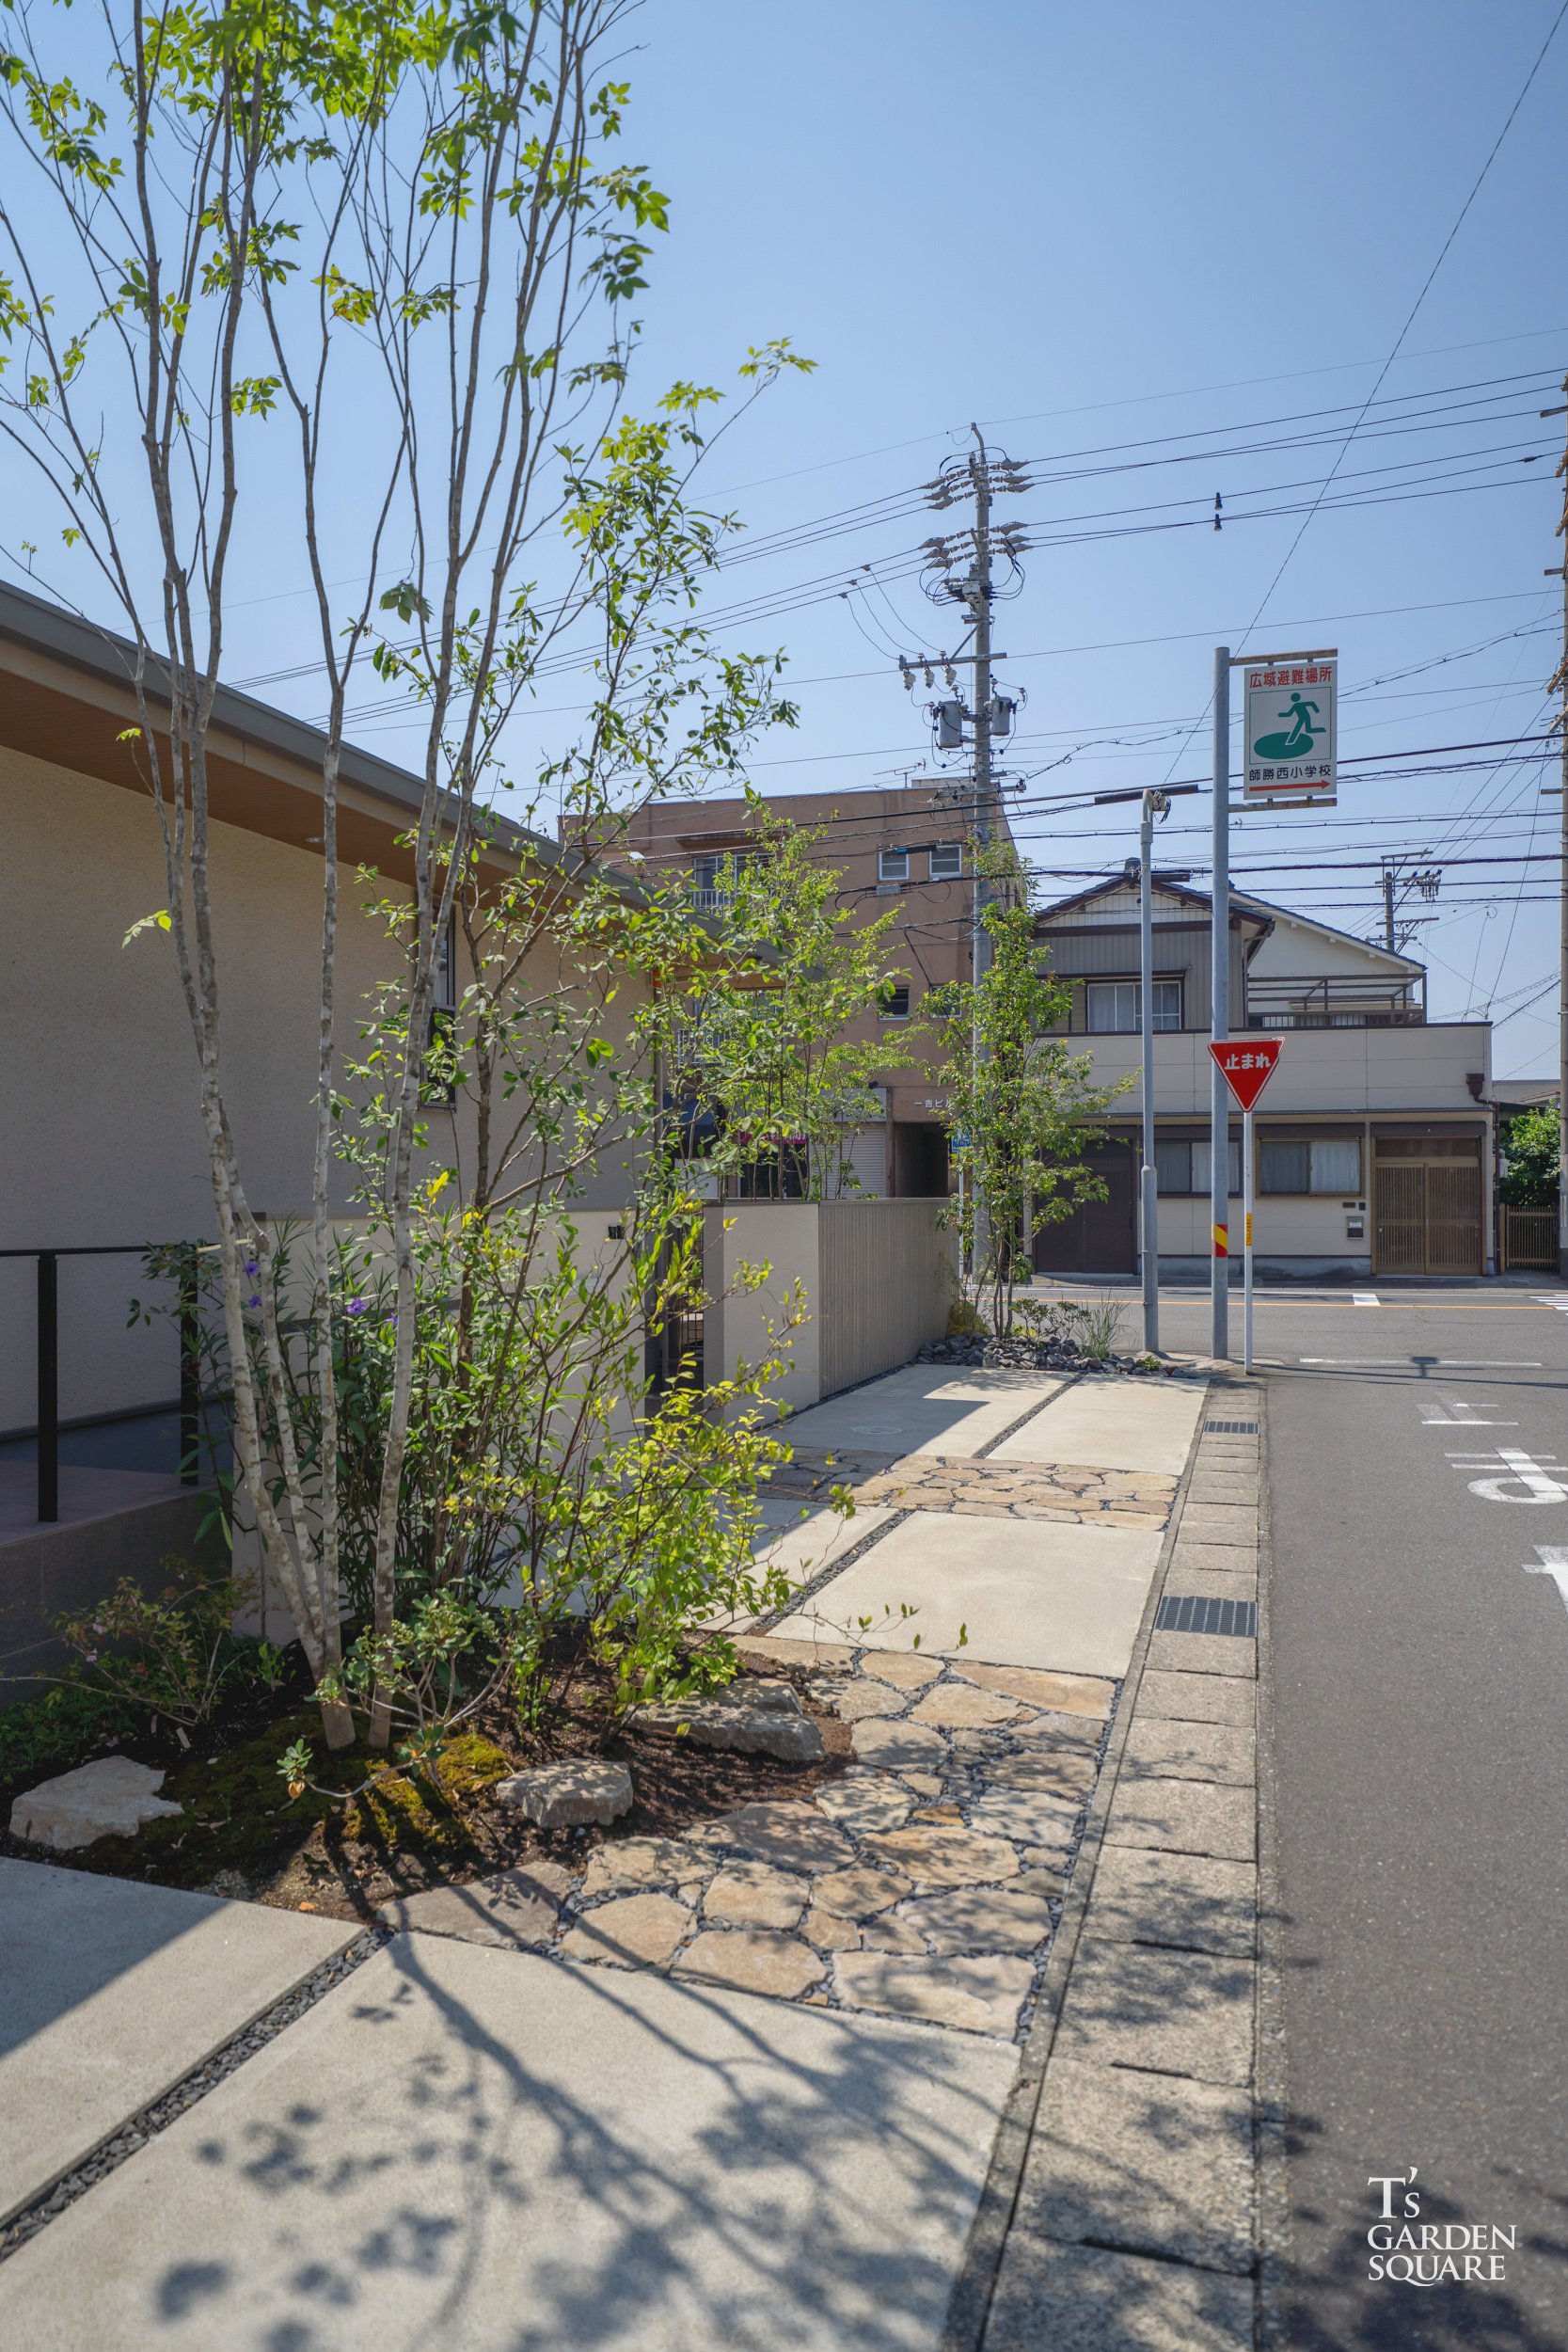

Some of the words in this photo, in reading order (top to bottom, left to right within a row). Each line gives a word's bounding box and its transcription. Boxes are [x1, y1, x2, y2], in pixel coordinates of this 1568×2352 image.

[1249, 666, 1332, 689] 広域避難場所
[1249, 764, 1332, 782] 師勝西小学校
[1224, 1052, 1271, 1070] 止まれ
